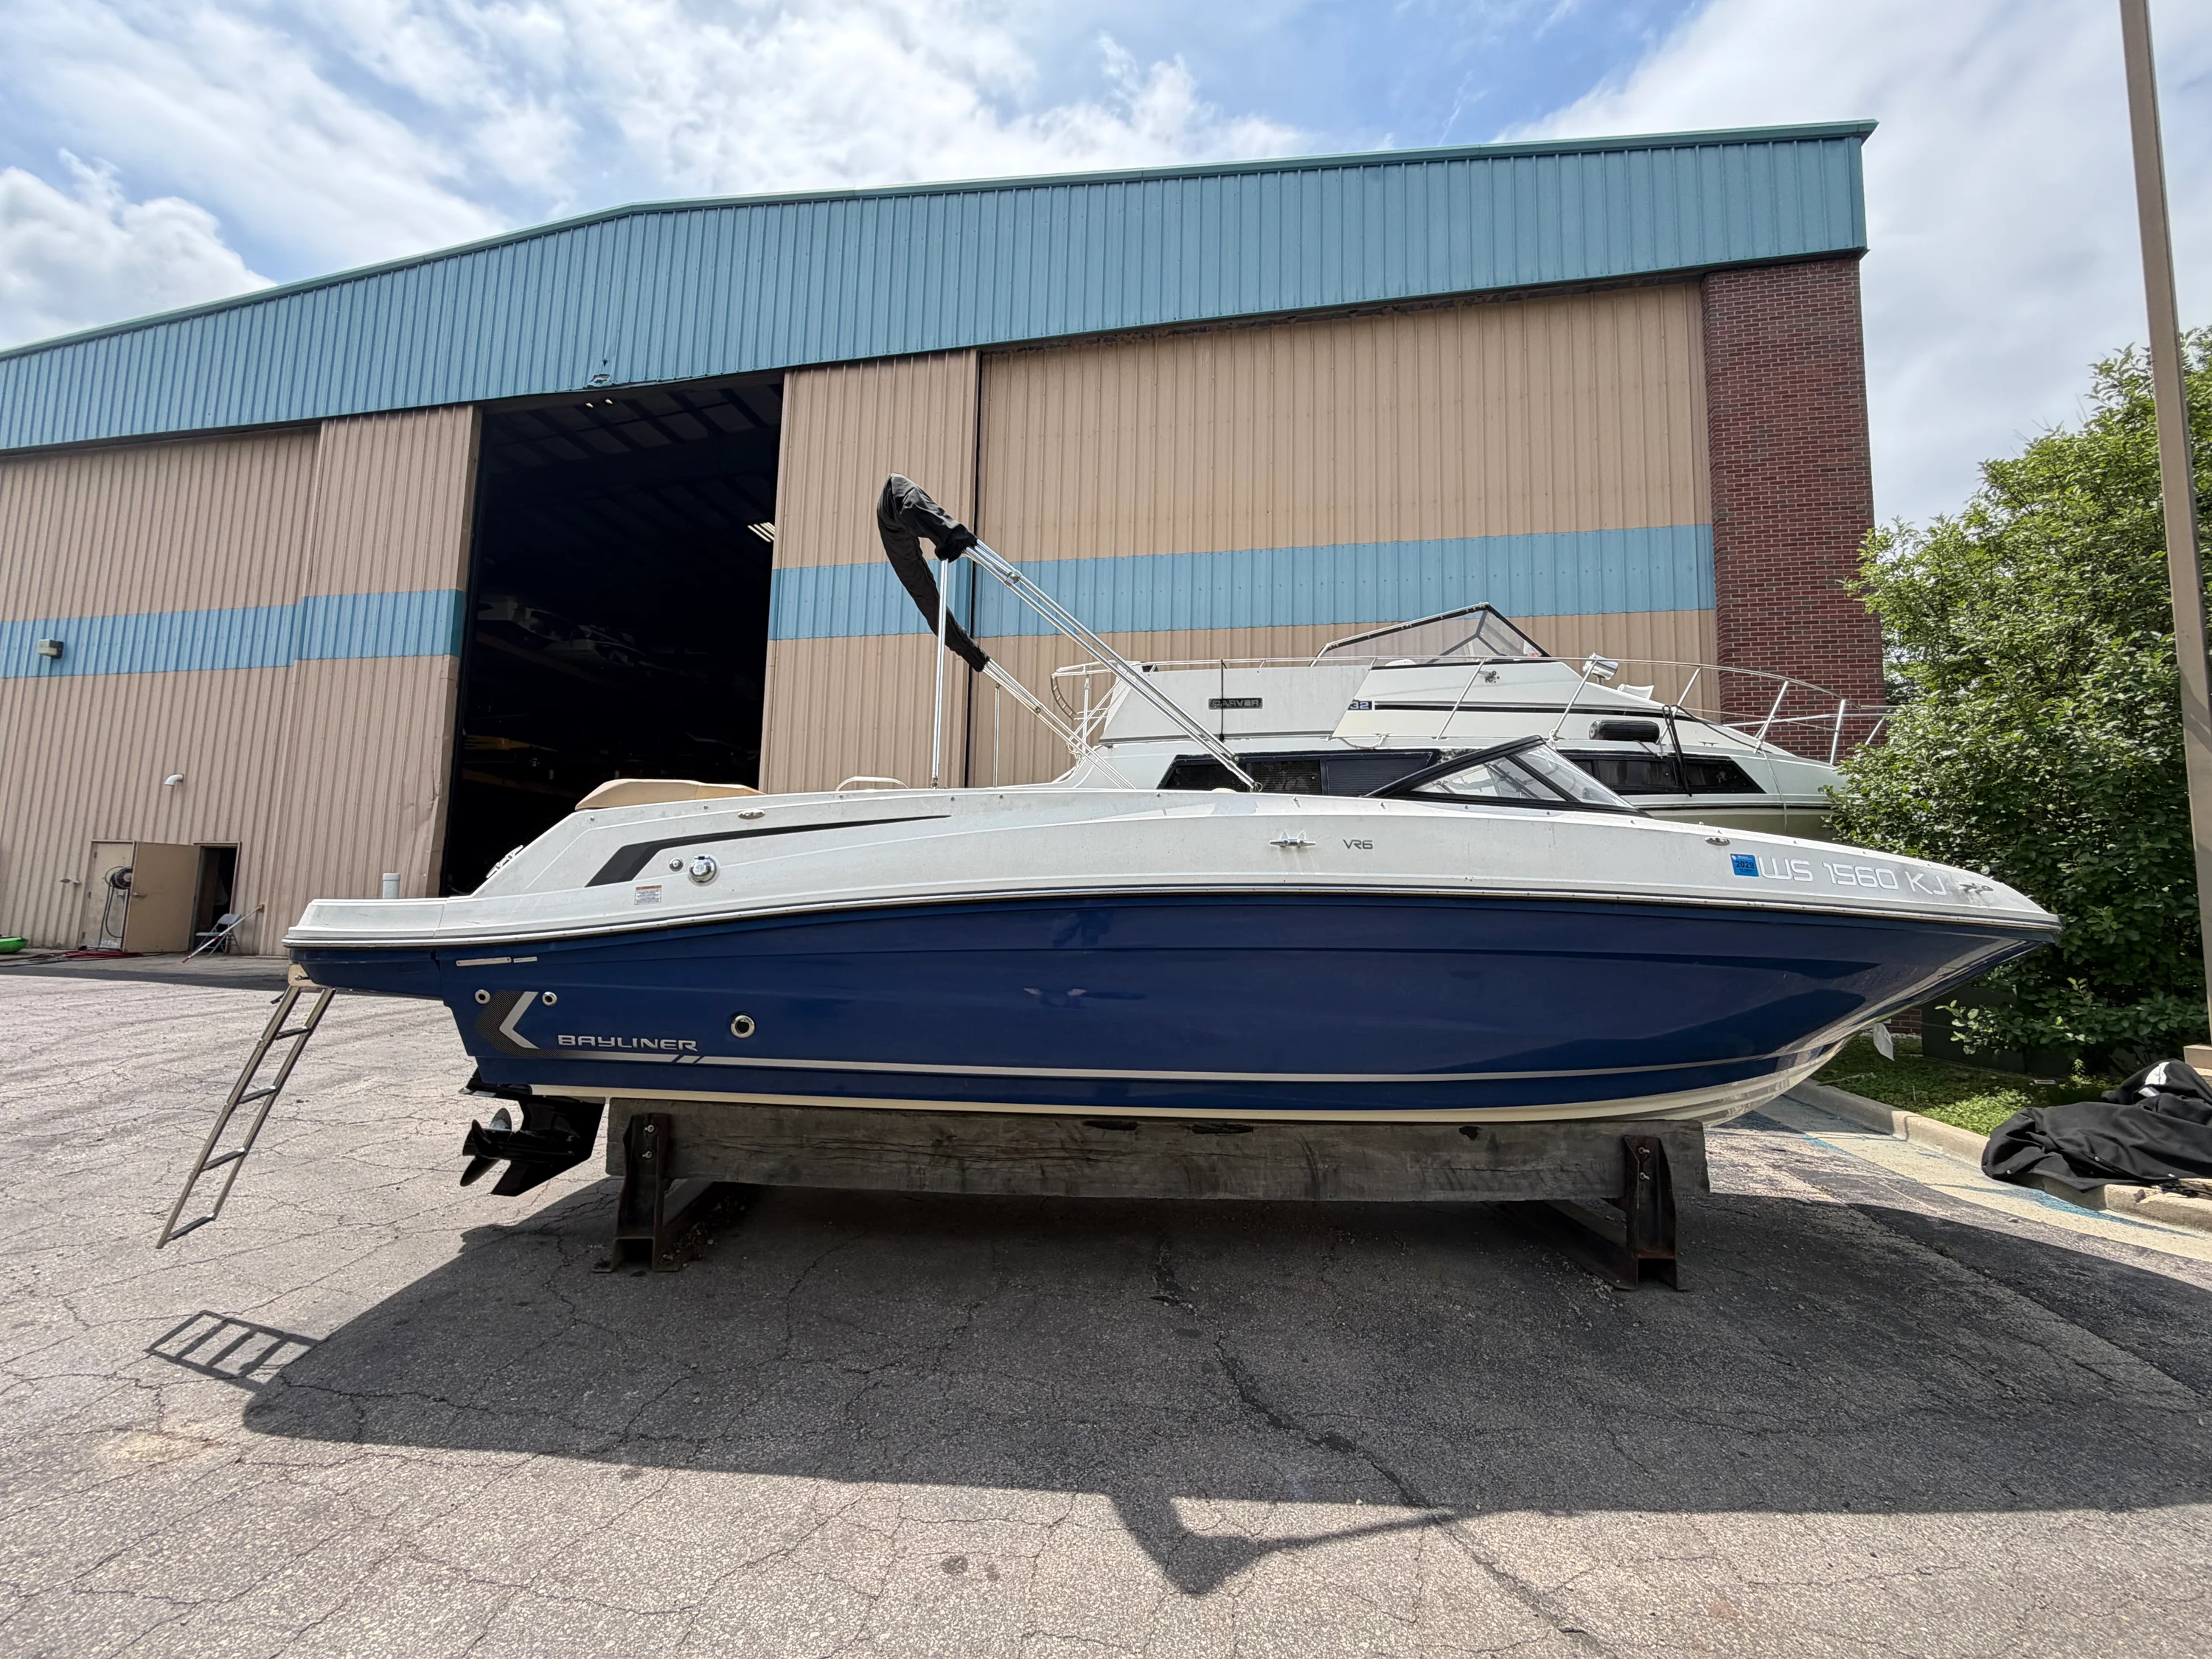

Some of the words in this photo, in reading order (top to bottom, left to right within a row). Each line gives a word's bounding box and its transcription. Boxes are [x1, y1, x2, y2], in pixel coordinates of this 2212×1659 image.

[1349, 701, 1369, 709] 32
[1343, 838, 1374, 849] VR6
[1735, 860, 1754, 869] 2029
[1758, 855, 1813, 881] WS
[1822, 861, 1899, 890] 1560
[1905, 870, 1947, 896] KJ
[557, 1034, 698, 1051] BAYLINER
